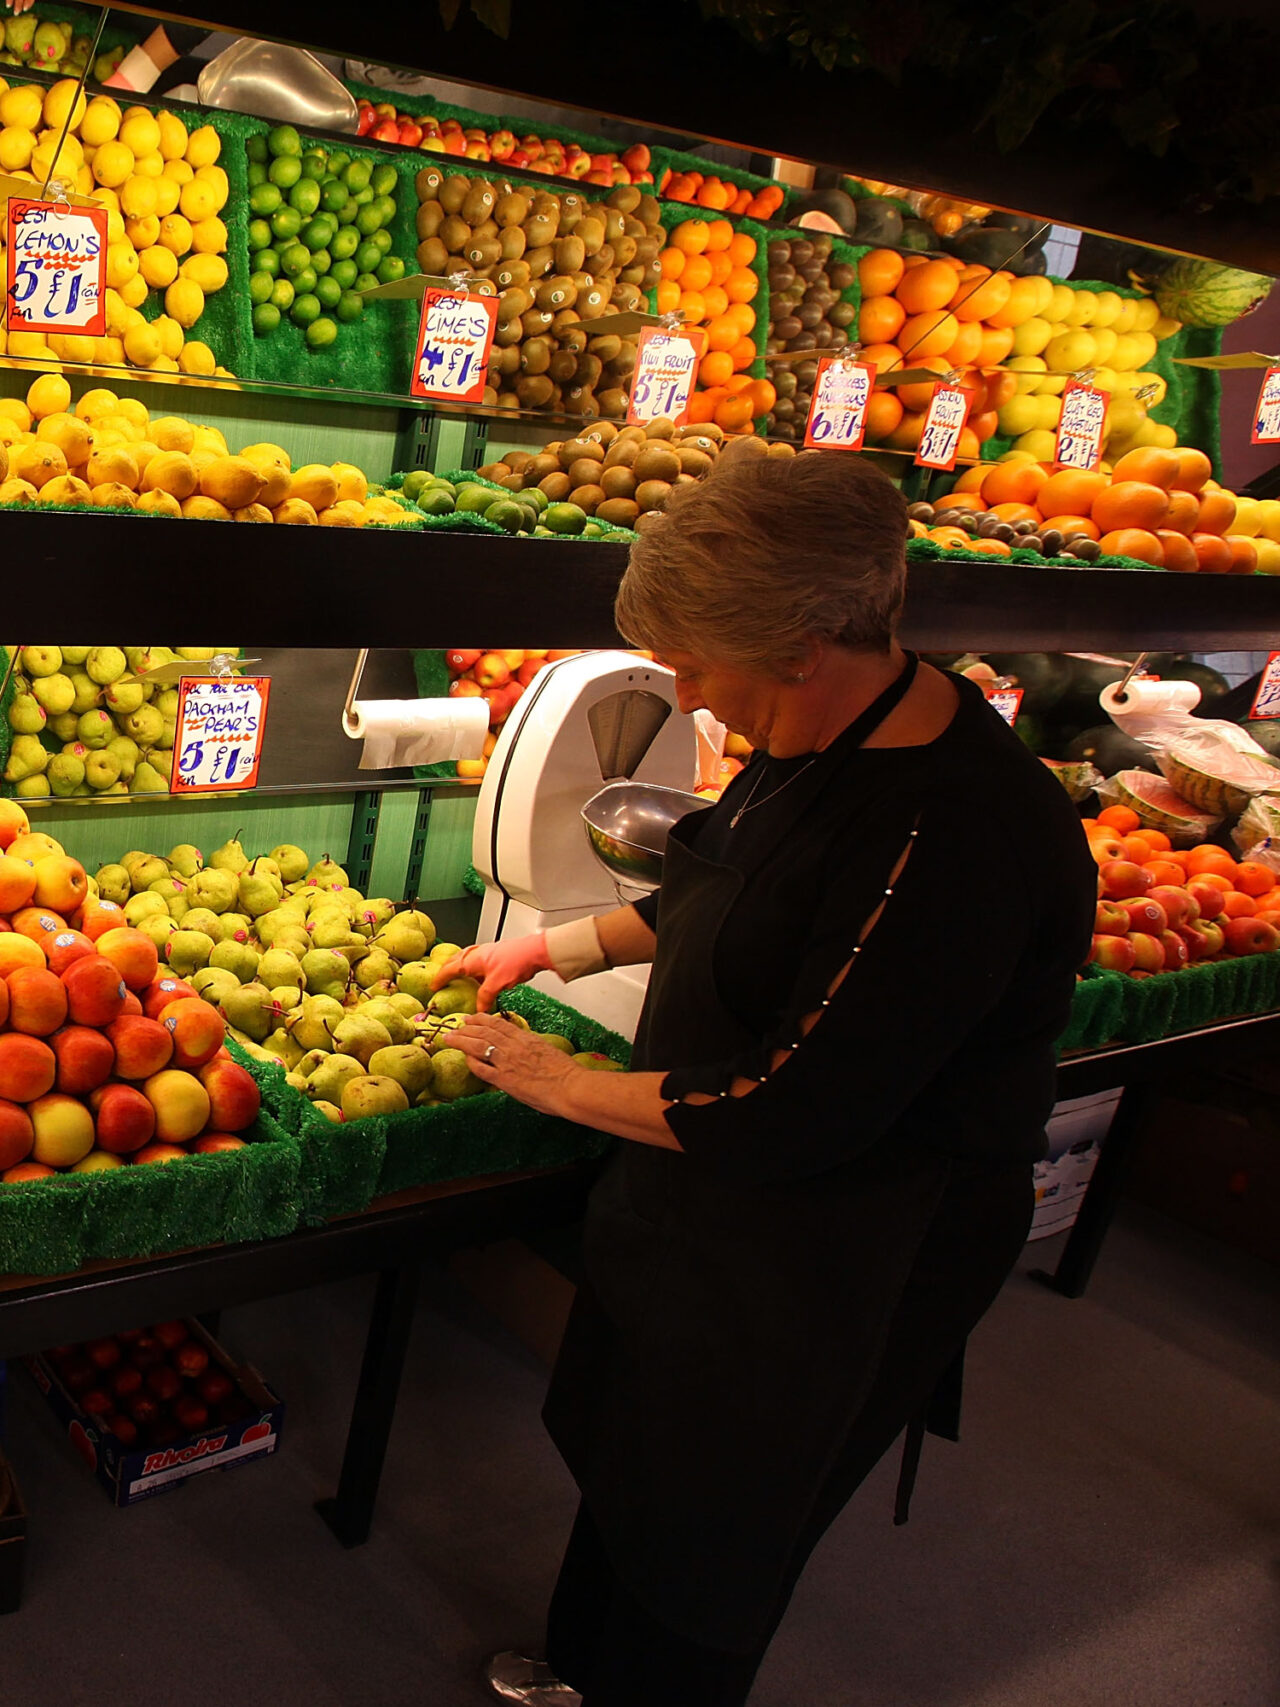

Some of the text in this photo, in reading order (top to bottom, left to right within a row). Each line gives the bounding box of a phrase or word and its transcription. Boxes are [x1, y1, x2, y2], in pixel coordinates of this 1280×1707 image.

[11, 204, 54, 225] BEST
[15, 228, 100, 255] LEMON'S
[8, 258, 44, 301] 5
[811, 411, 832, 440] 6
[920, 427, 935, 458] 3
